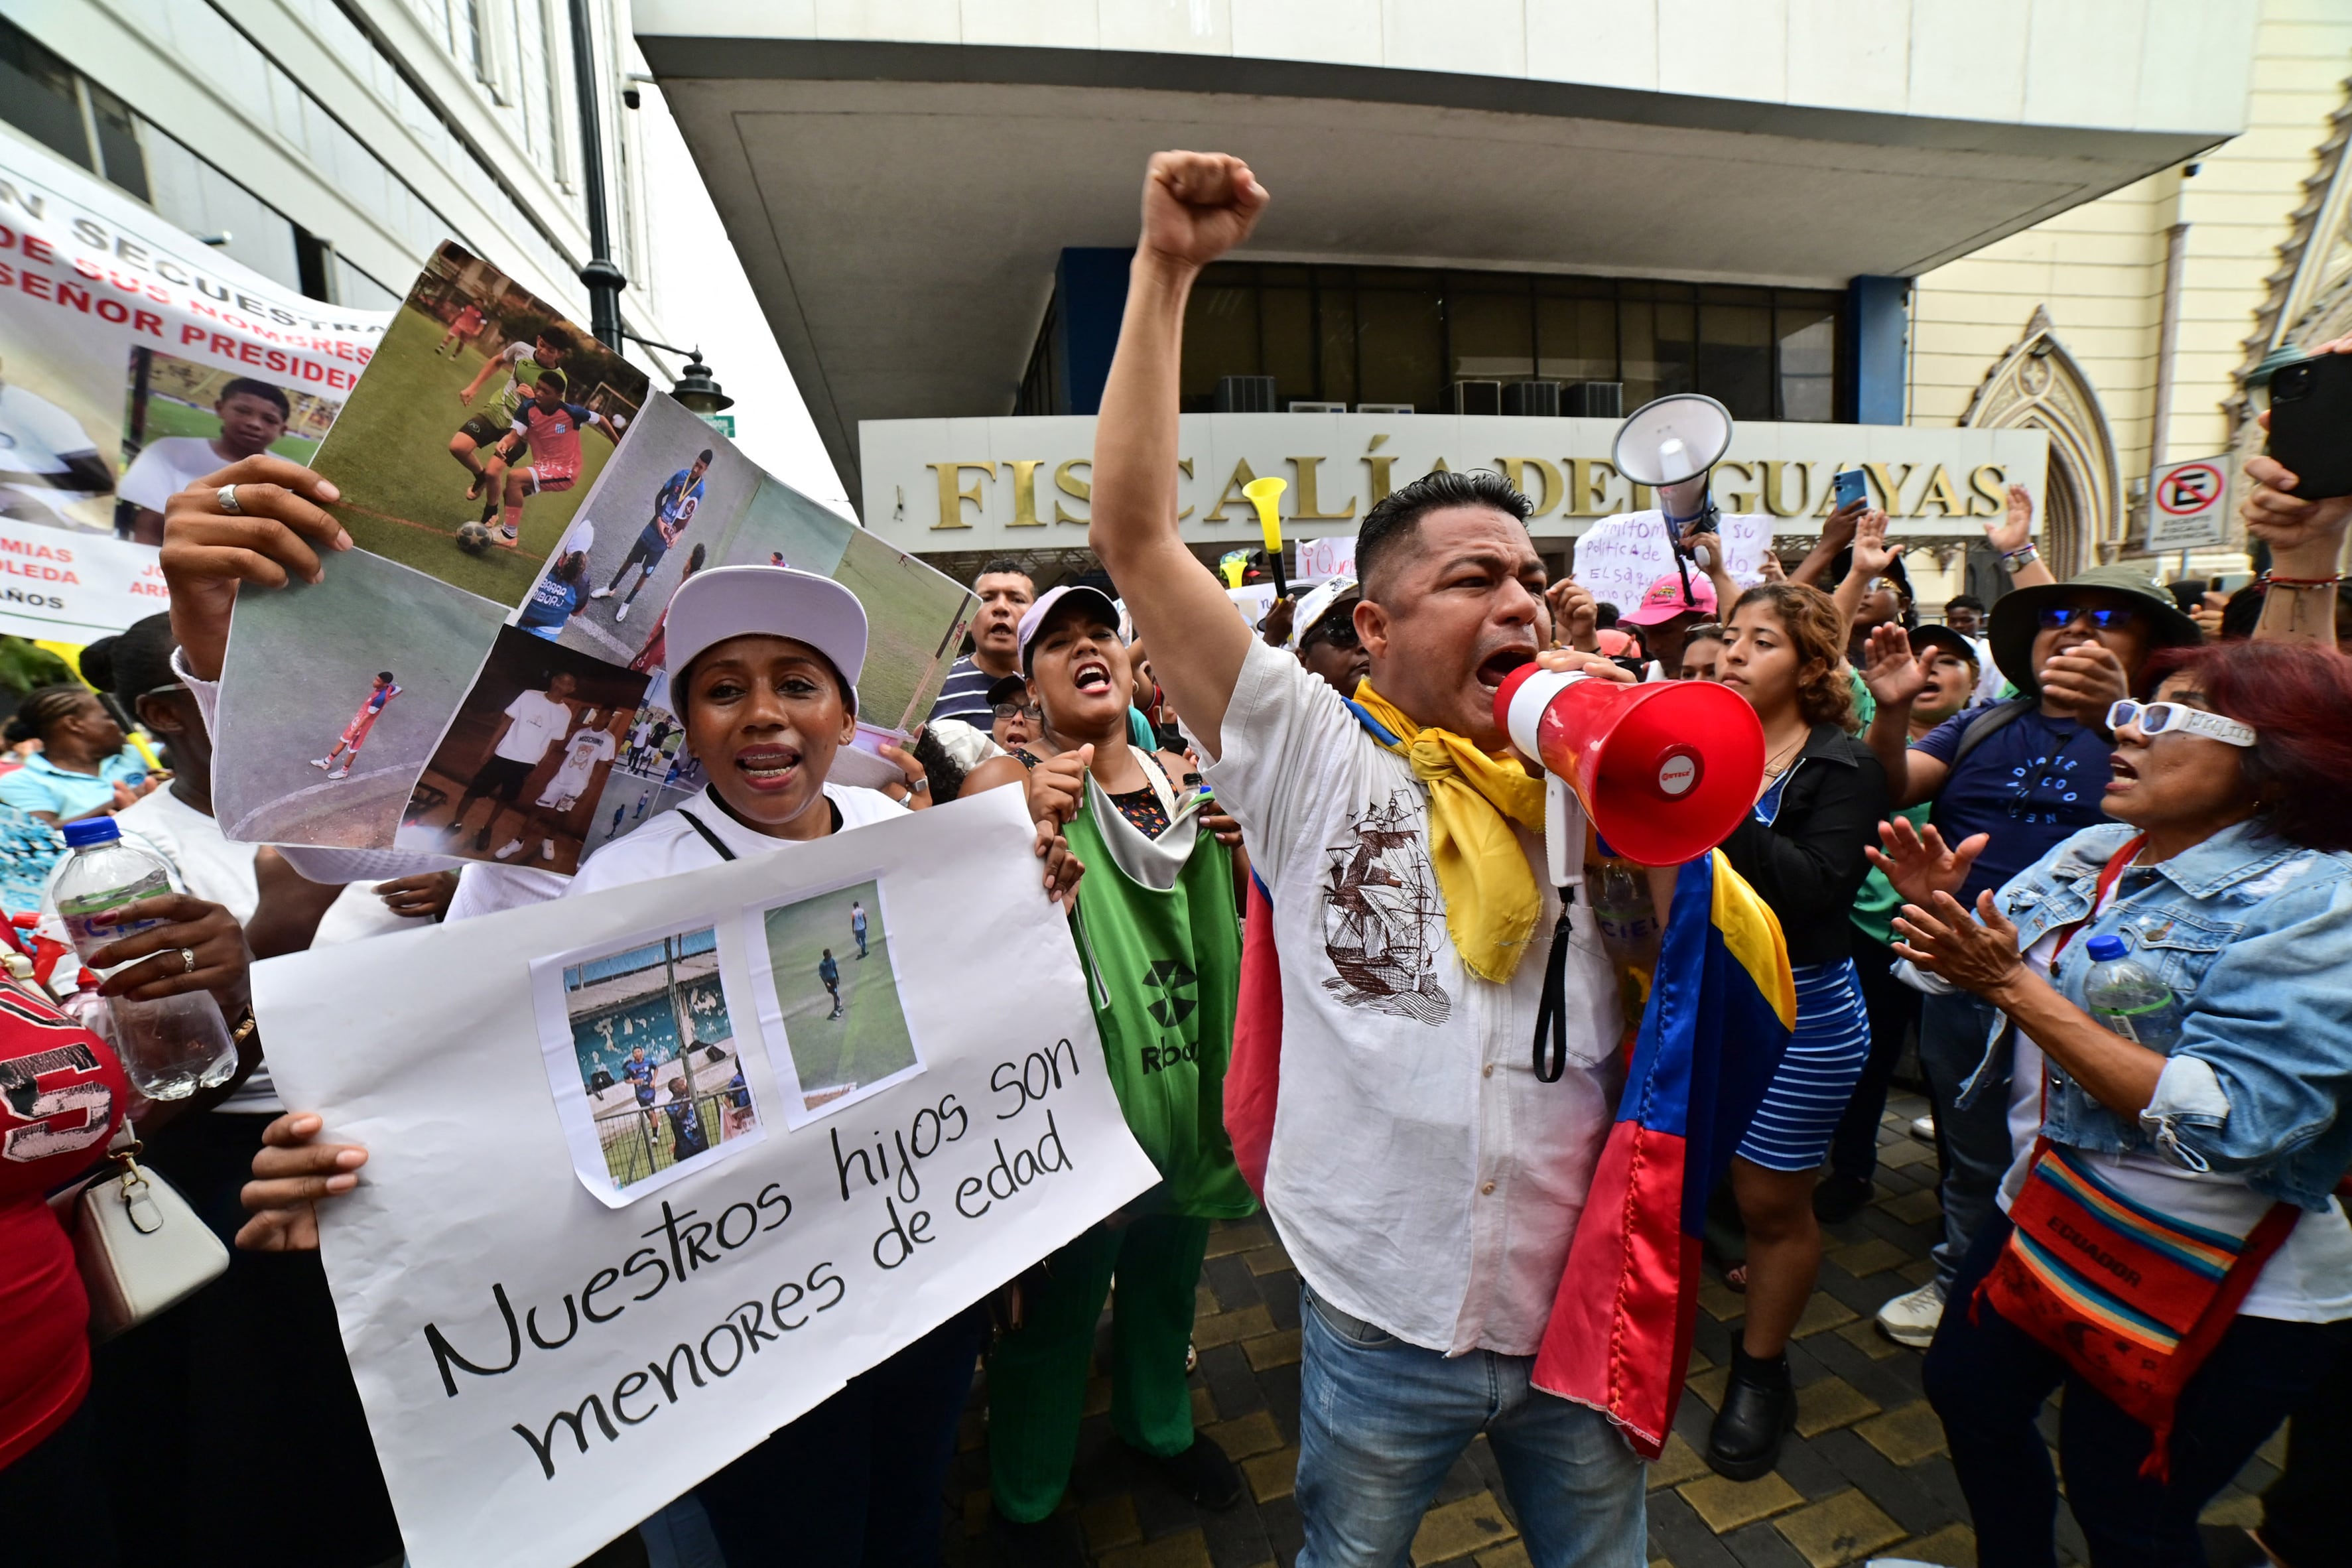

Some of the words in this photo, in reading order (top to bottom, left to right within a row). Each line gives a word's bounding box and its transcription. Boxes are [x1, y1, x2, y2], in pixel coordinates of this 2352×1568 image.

[830, 1094, 968, 1203] hijos
[990, 1037, 1080, 1121] son
[874, 1197, 936, 1269] de
[956, 1109, 1073, 1218] edad
[2047, 1214, 2142, 1289] ECUADOR
